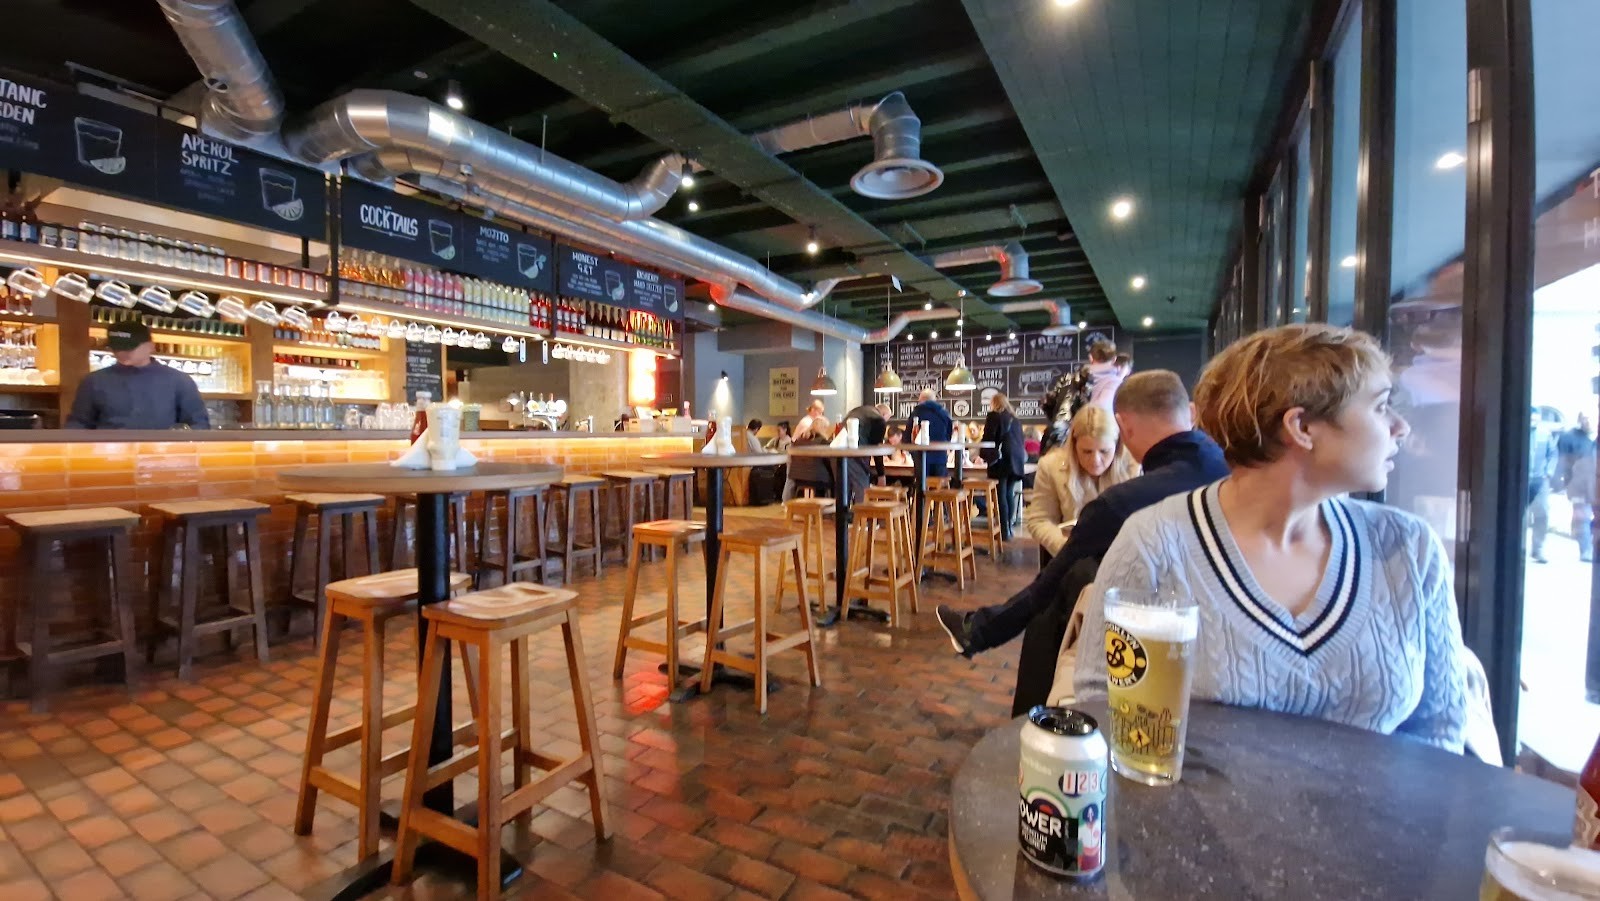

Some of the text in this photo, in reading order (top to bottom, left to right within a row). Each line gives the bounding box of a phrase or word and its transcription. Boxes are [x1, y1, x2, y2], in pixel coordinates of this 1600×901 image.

[181, 132, 239, 164] APEROL
[181, 150, 232, 176] SPRITZ
[360, 203, 419, 237] COCKTAILS
[479, 225, 509, 244] MOJITO
[572, 251, 599, 267] HONEST
[954, 342, 967, 350] WIH
[976, 339, 1020, 358] CHOPPED
[1030, 336, 1073, 349] FRESH
[900, 346, 924, 354] GREAT
[900, 353, 925, 361] BRITISH
[977, 369, 1003, 380] ALWAYS
[1015, 408, 1034, 416] GOOD
